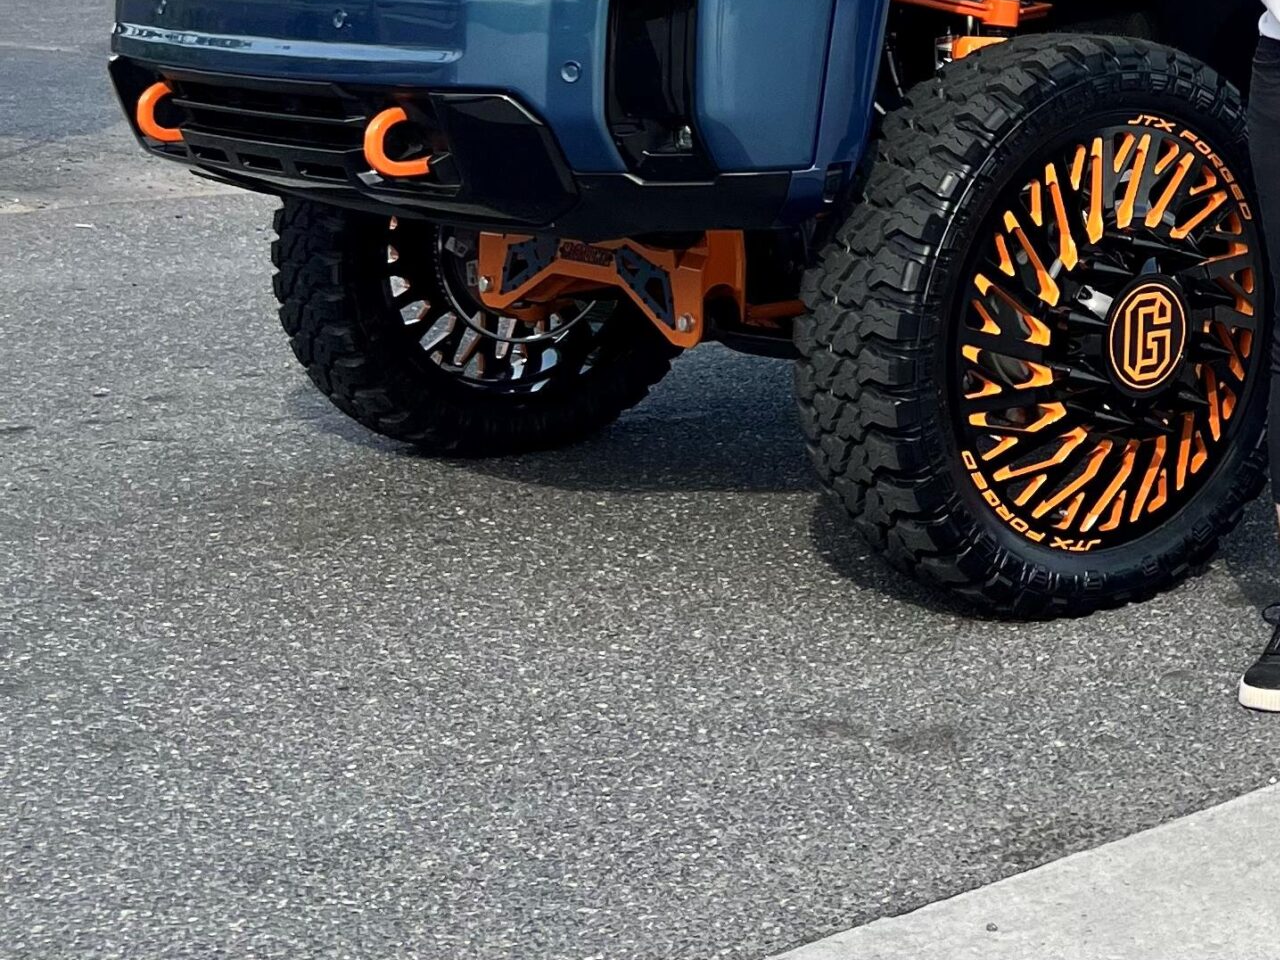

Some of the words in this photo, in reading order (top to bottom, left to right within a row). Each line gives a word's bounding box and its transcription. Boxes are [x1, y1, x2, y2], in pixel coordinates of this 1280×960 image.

[1127, 114, 1177, 133] JTX
[1179, 129, 1252, 220] FORGED
[961, 450, 1047, 543] FORGED
[1049, 536, 1101, 552] JTX
